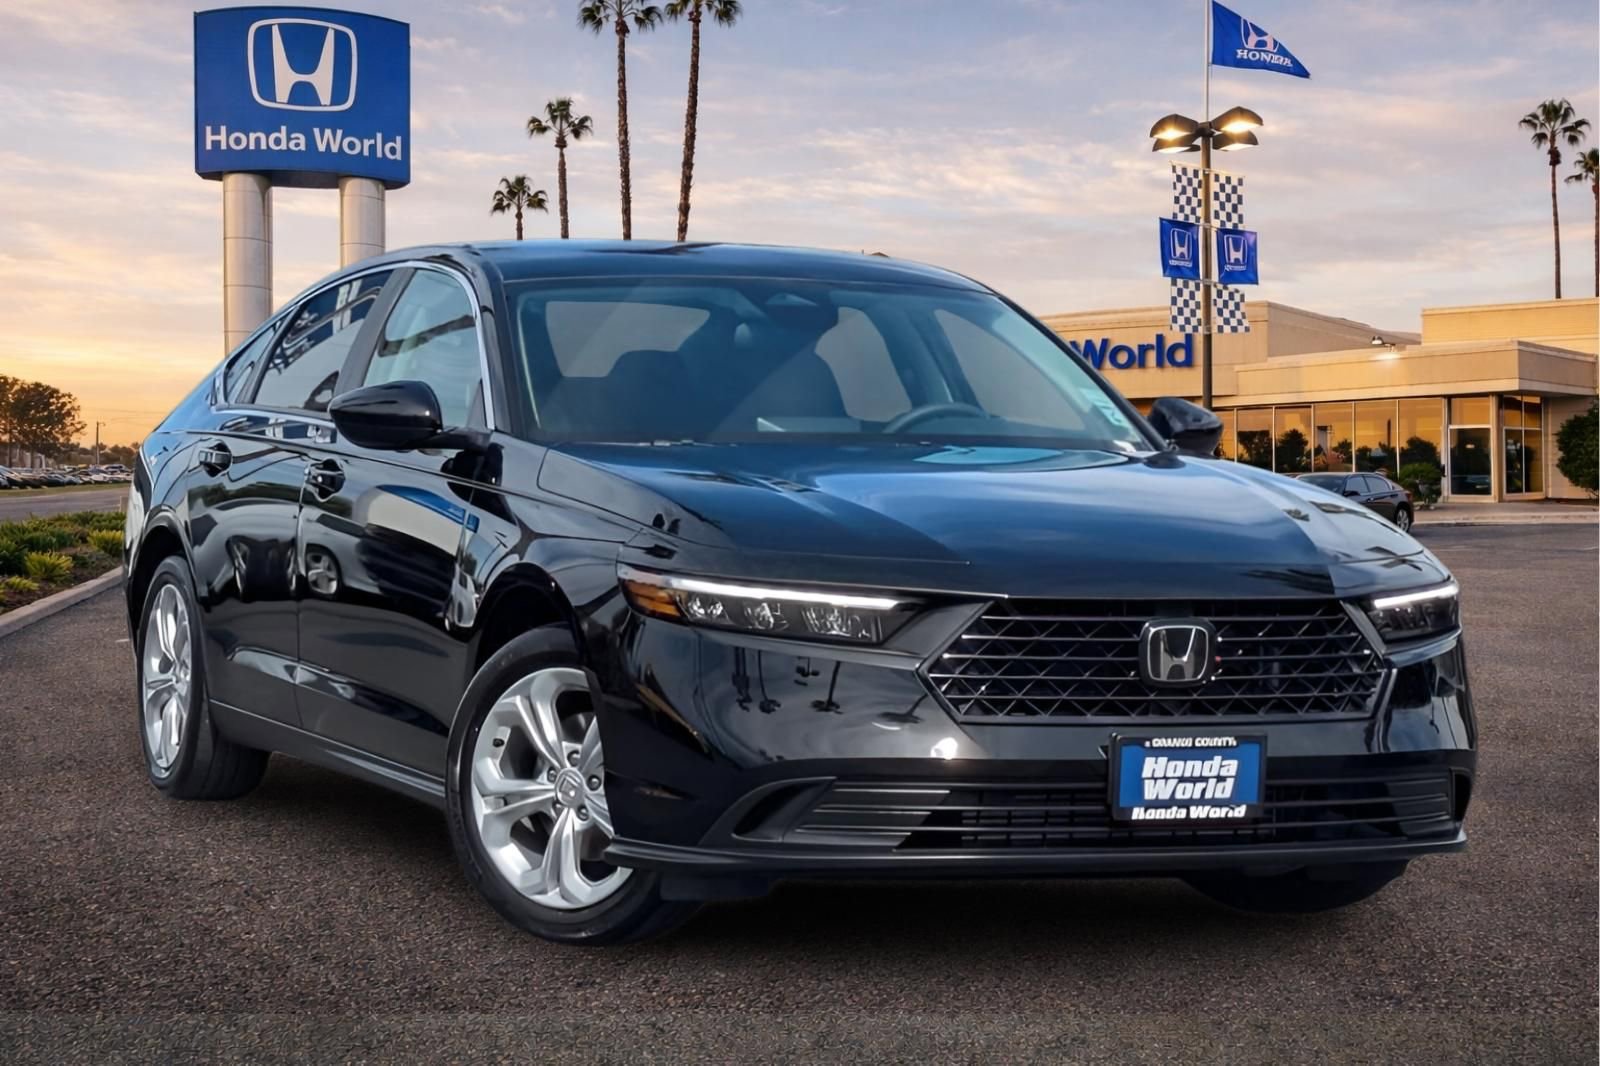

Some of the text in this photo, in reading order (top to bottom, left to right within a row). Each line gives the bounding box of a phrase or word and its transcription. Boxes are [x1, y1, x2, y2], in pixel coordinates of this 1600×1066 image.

[205, 125, 402, 161] Honda World
[1069, 333, 1194, 370] World
[1141, 756, 1239, 778] Honda
[1143, 777, 1235, 800] World
[1131, 806, 1187, 820] Honda
